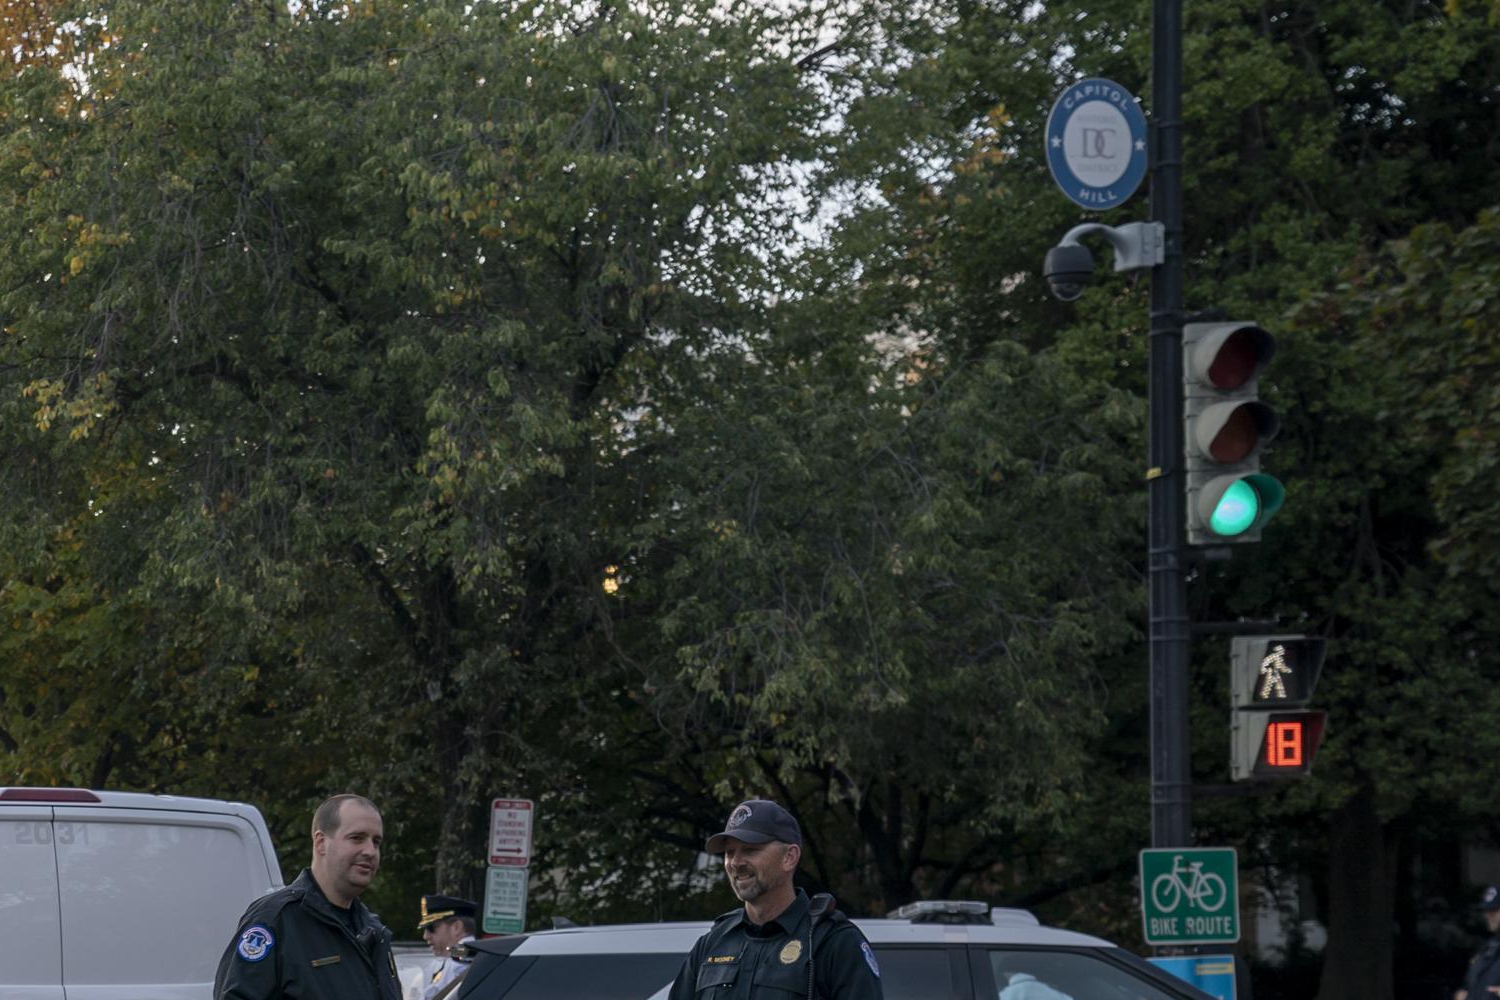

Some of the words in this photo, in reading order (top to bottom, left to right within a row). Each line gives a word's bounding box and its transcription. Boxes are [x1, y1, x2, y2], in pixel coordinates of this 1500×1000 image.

[1064, 85, 1128, 110] CAPITOL
[1082, 128, 1117, 159] DC
[1080, 188, 1117, 203] HILL
[1268, 722, 1301, 766] 18
[14, 821, 90, 846] 2031
[1151, 916, 1179, 936] BIKE
[1185, 916, 1233, 935] ROUTE
